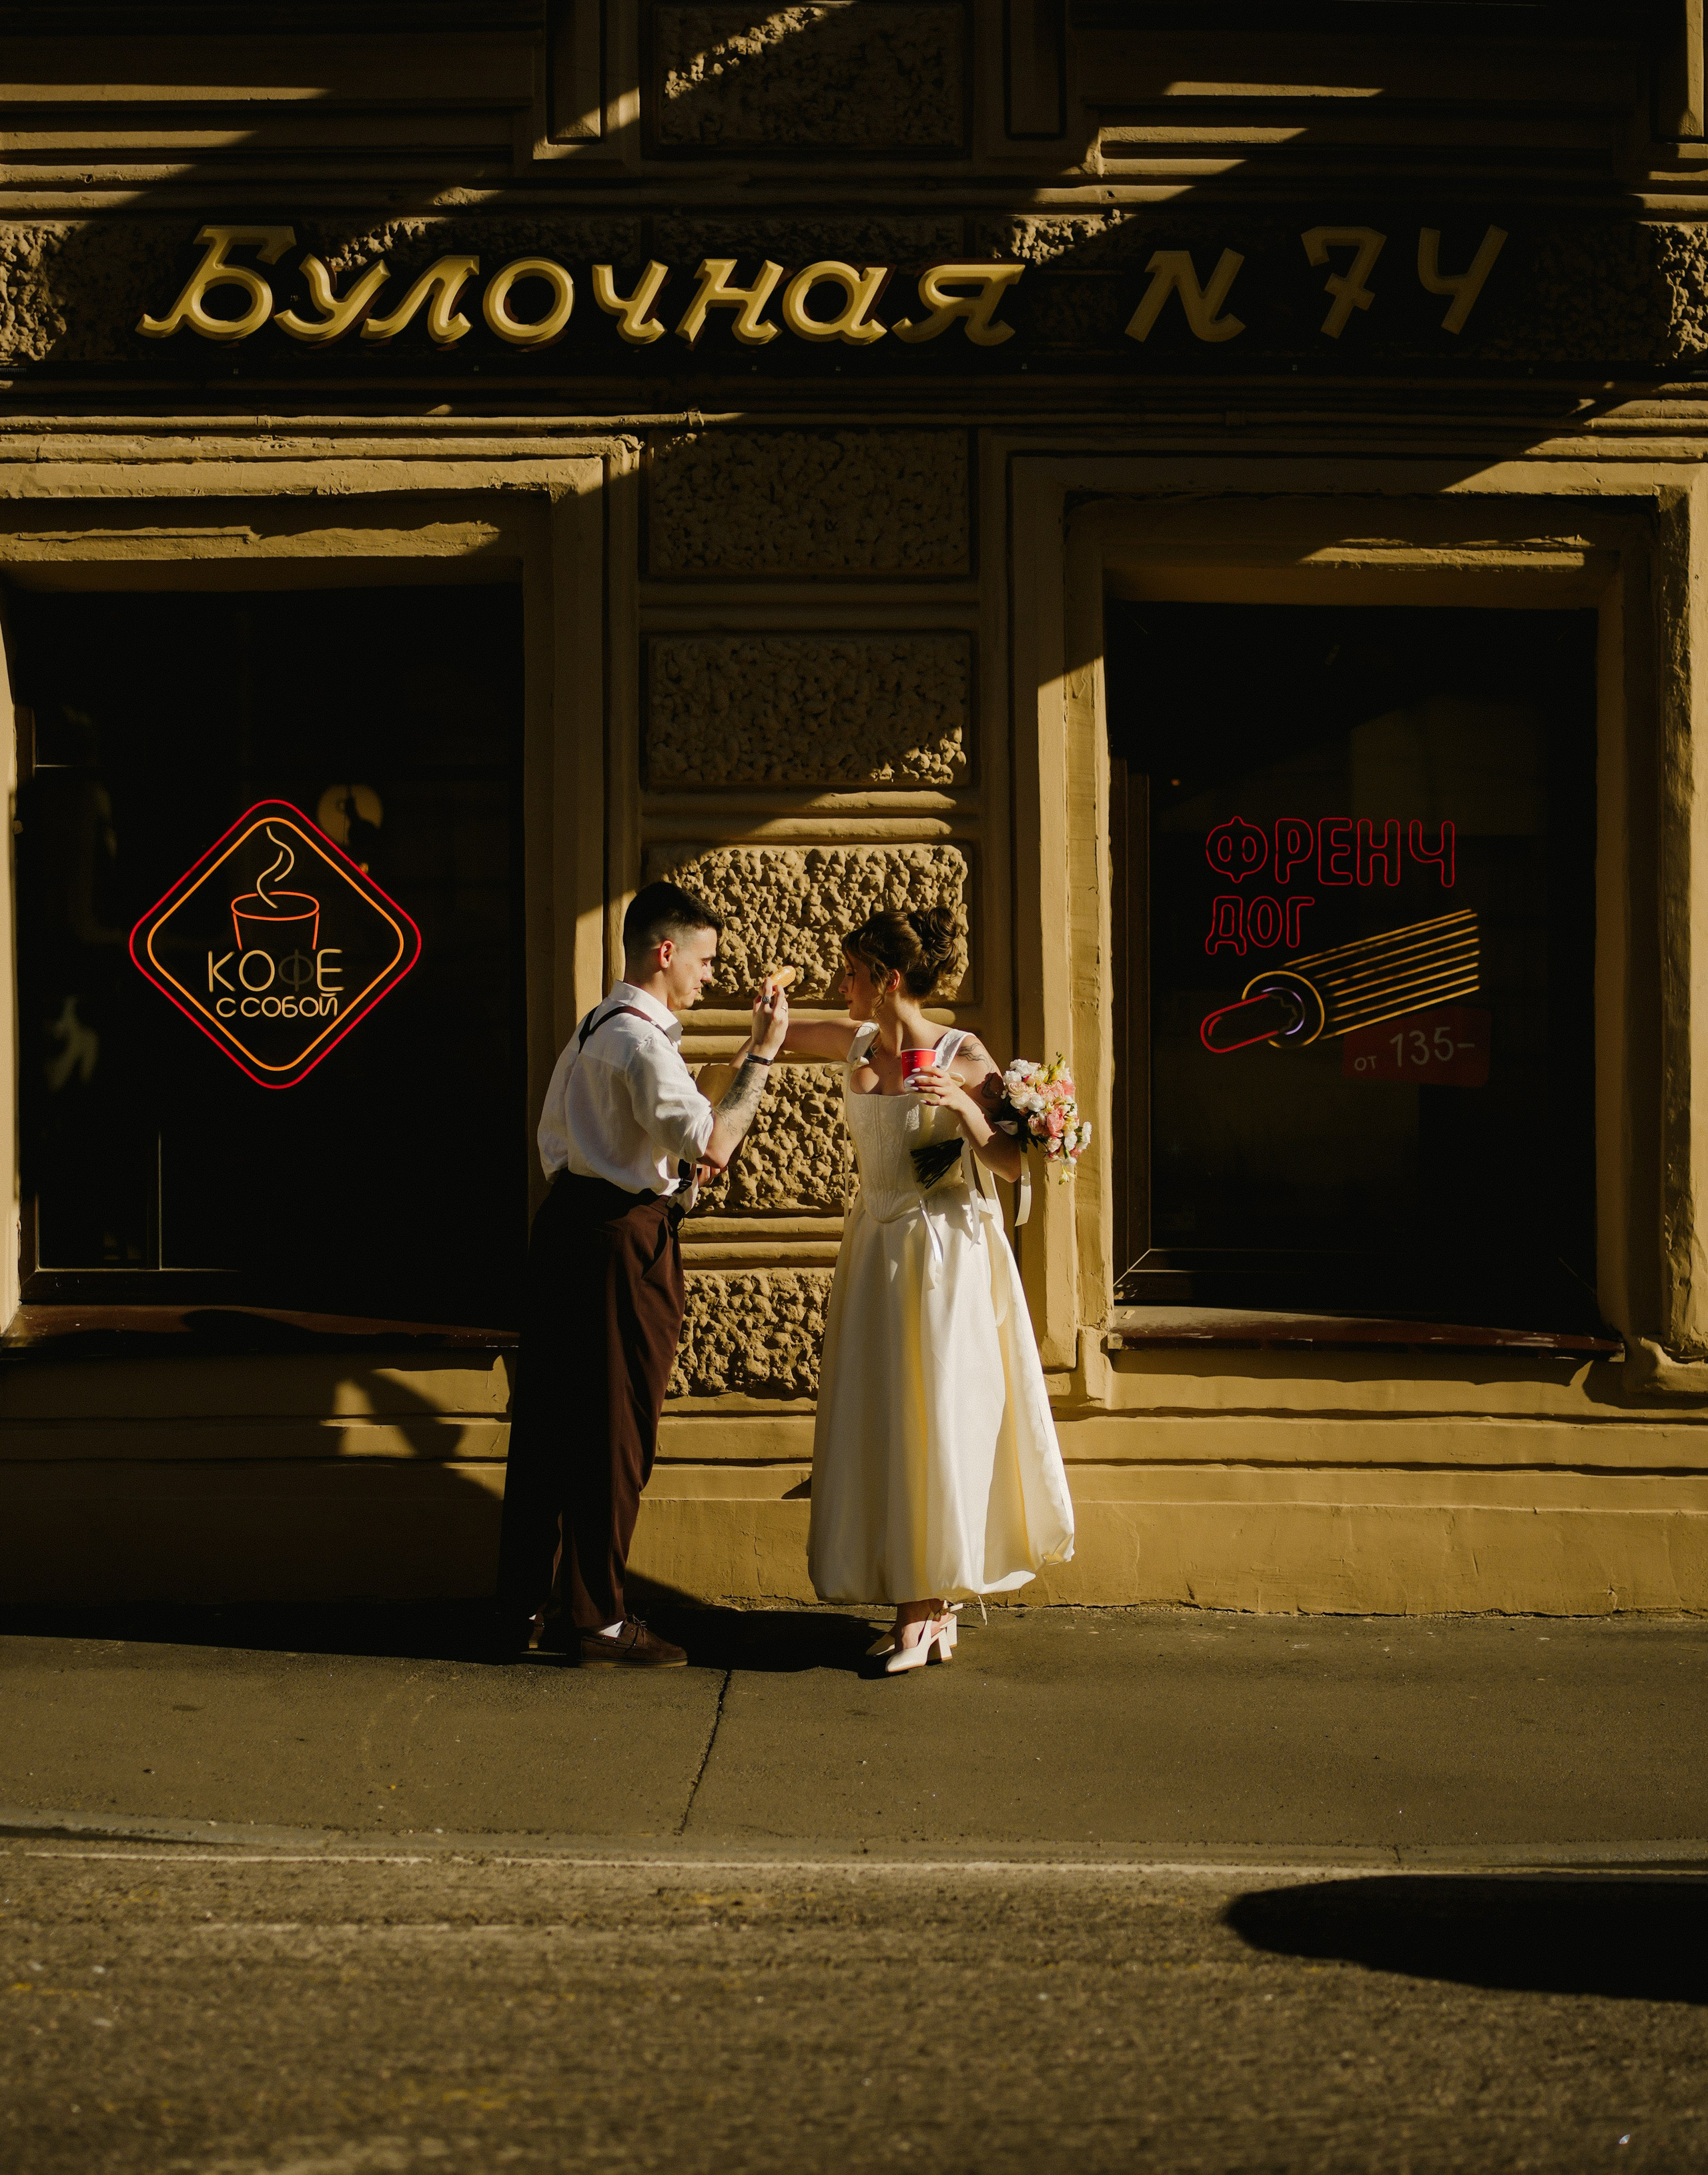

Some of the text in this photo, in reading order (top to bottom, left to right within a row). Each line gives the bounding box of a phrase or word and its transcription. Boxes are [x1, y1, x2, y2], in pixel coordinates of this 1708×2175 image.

[134, 225, 1025, 345] Булочная
[1206, 816, 1455, 887] ФРЕНЧ
[1205, 895, 1315, 955] ДОГ
[208, 949, 344, 992] КОФЕ
